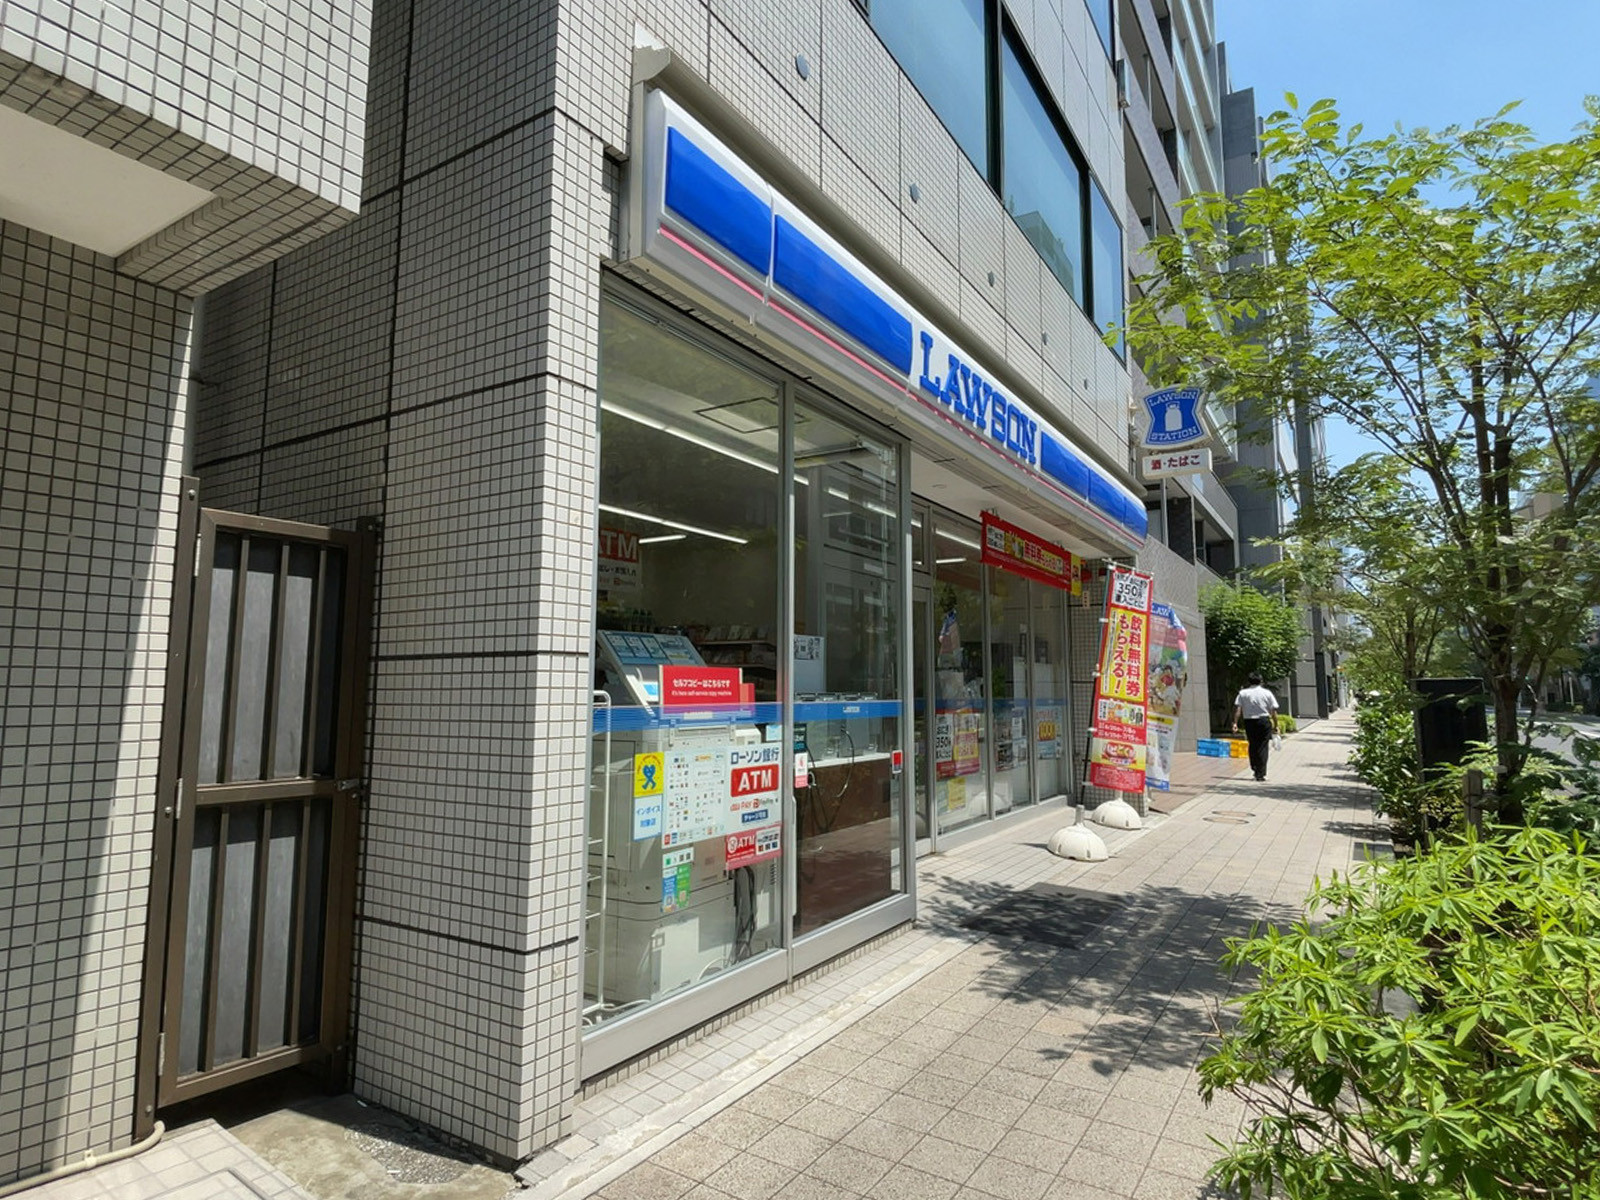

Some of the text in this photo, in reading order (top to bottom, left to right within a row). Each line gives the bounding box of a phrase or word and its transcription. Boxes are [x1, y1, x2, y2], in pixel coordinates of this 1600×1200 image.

[919, 330, 1037, 465] LAWSON
[1149, 391, 1197, 407] LAWSON
[1151, 426, 1198, 441] STATION
[1151, 454, 1200, 470] 酒・たばこ
[598, 529, 638, 561] TM
[1125, 615, 1142, 697] 飲料無料券
[673, 678, 731, 688] セルフコピーはこちらです
[731, 747, 780, 765] ローソン銀行
[738, 769, 772, 792] ATM
[636, 805, 661, 816] インボイス
